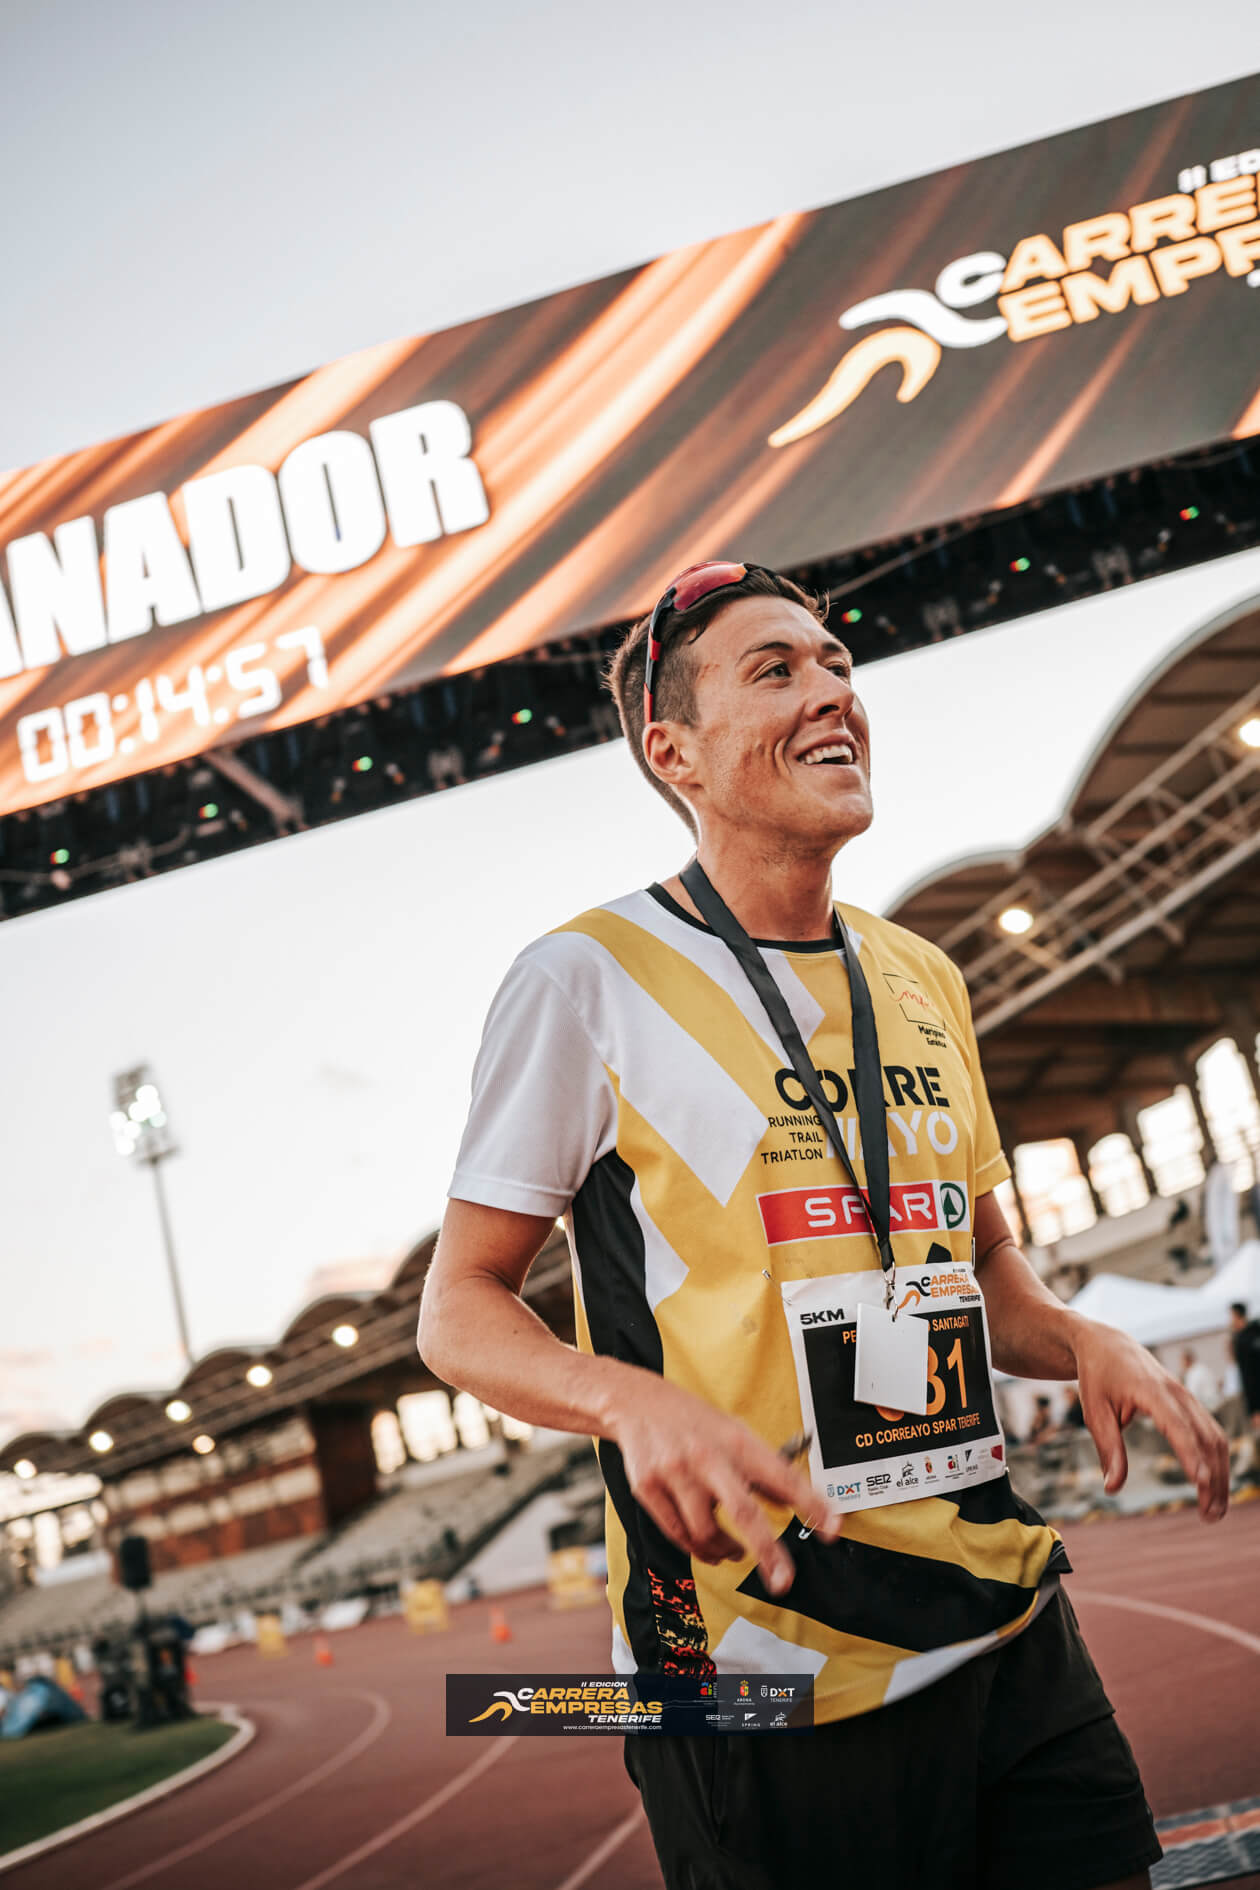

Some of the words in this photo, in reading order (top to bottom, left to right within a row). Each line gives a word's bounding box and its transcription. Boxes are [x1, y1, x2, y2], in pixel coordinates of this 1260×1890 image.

[935, 172, 1260, 308] CARRE
[0, 400, 490, 679] NADOR
[17, 626, 329, 783] 00:14:57
[774, 1065, 950, 1112] CORE
[768, 1115, 824, 1127] RUNNING
[789, 1132, 823, 1143] TRAIL
[761, 1148, 823, 1165] TRIATLON
[804, 1192, 933, 1228] SPR
[800, 1308, 845, 1325] 5KM
[855, 1433, 873, 1448] CD
[875, 1423, 931, 1445] CORREAYO
[932, 1418, 957, 1434] SPAR
[837, 1482, 861, 1496] DXT
[866, 1473, 892, 1487] SER
